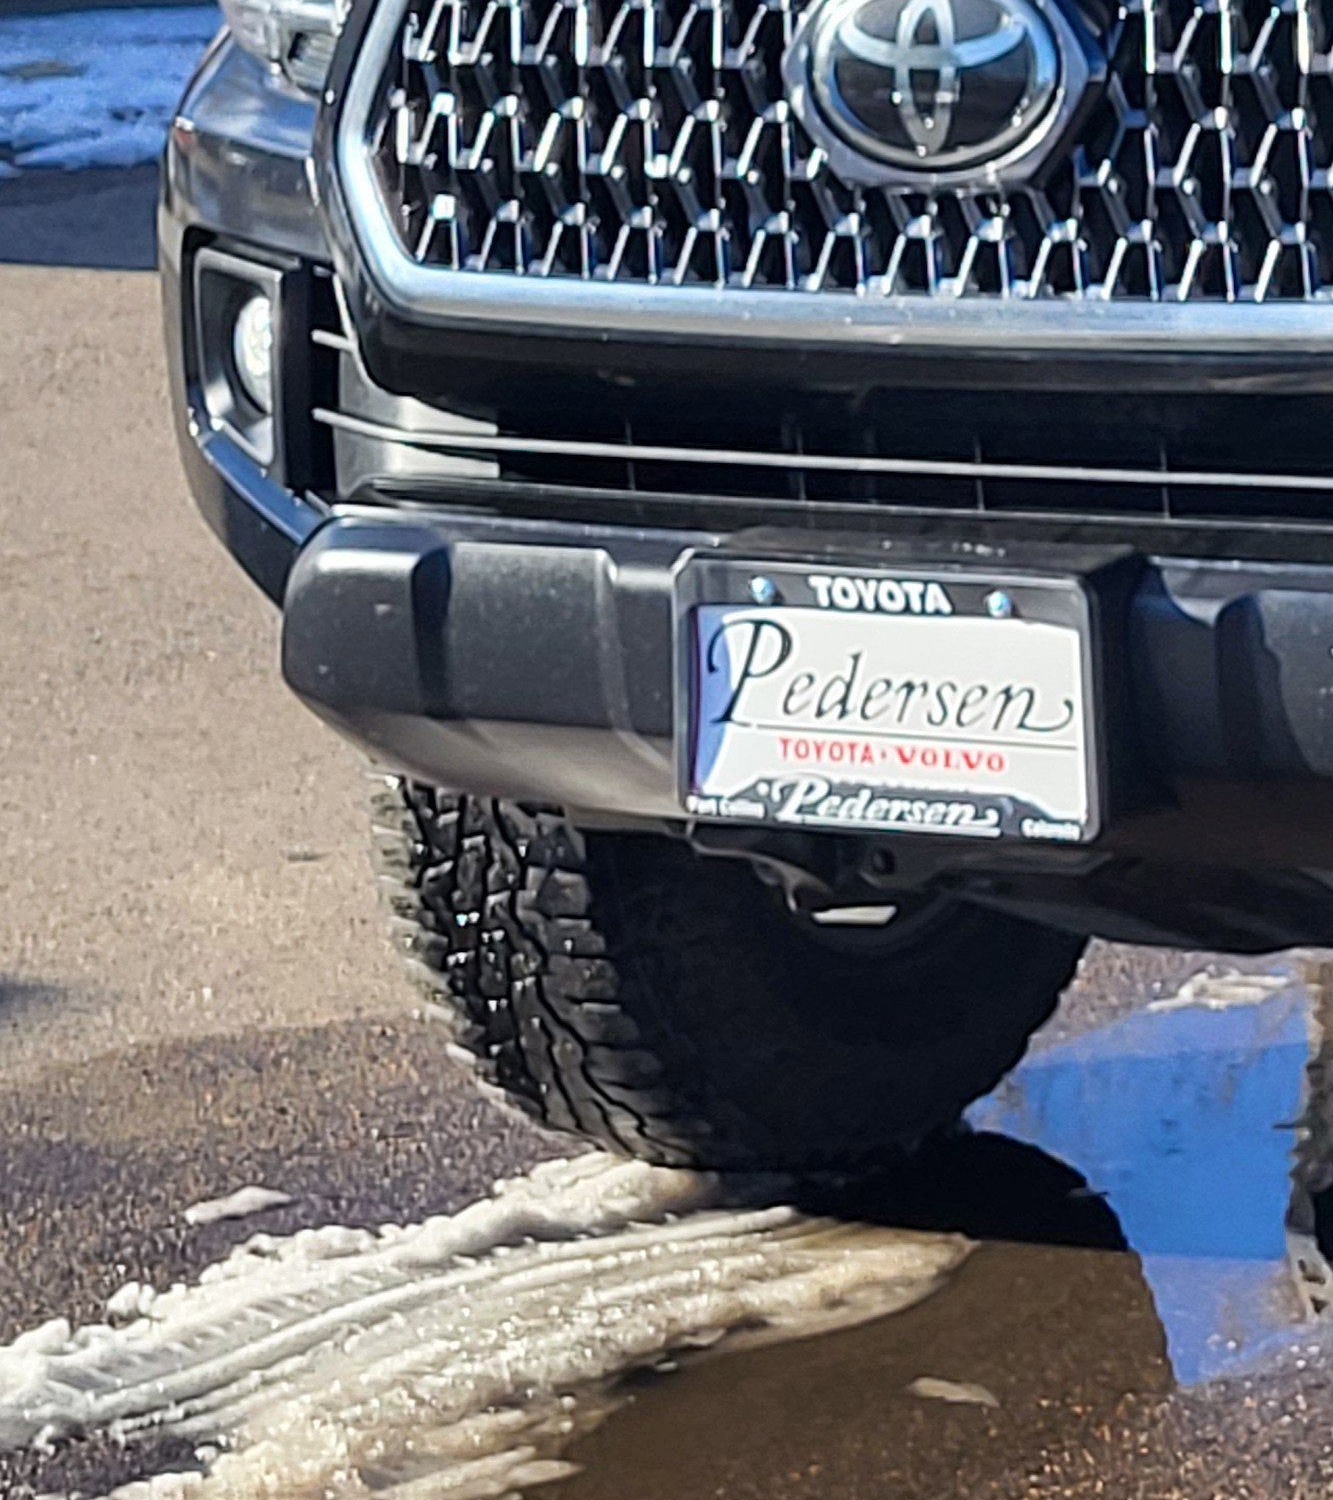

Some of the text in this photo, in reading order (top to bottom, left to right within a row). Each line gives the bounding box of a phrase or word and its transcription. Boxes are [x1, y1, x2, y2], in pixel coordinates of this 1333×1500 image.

[808, 575, 953, 614] TOYOTA
[707, 618, 1074, 732] Pedersen
[778, 737, 1006, 773] TOYOTA VOLVO
[757, 773, 1000, 831] Pedersen
